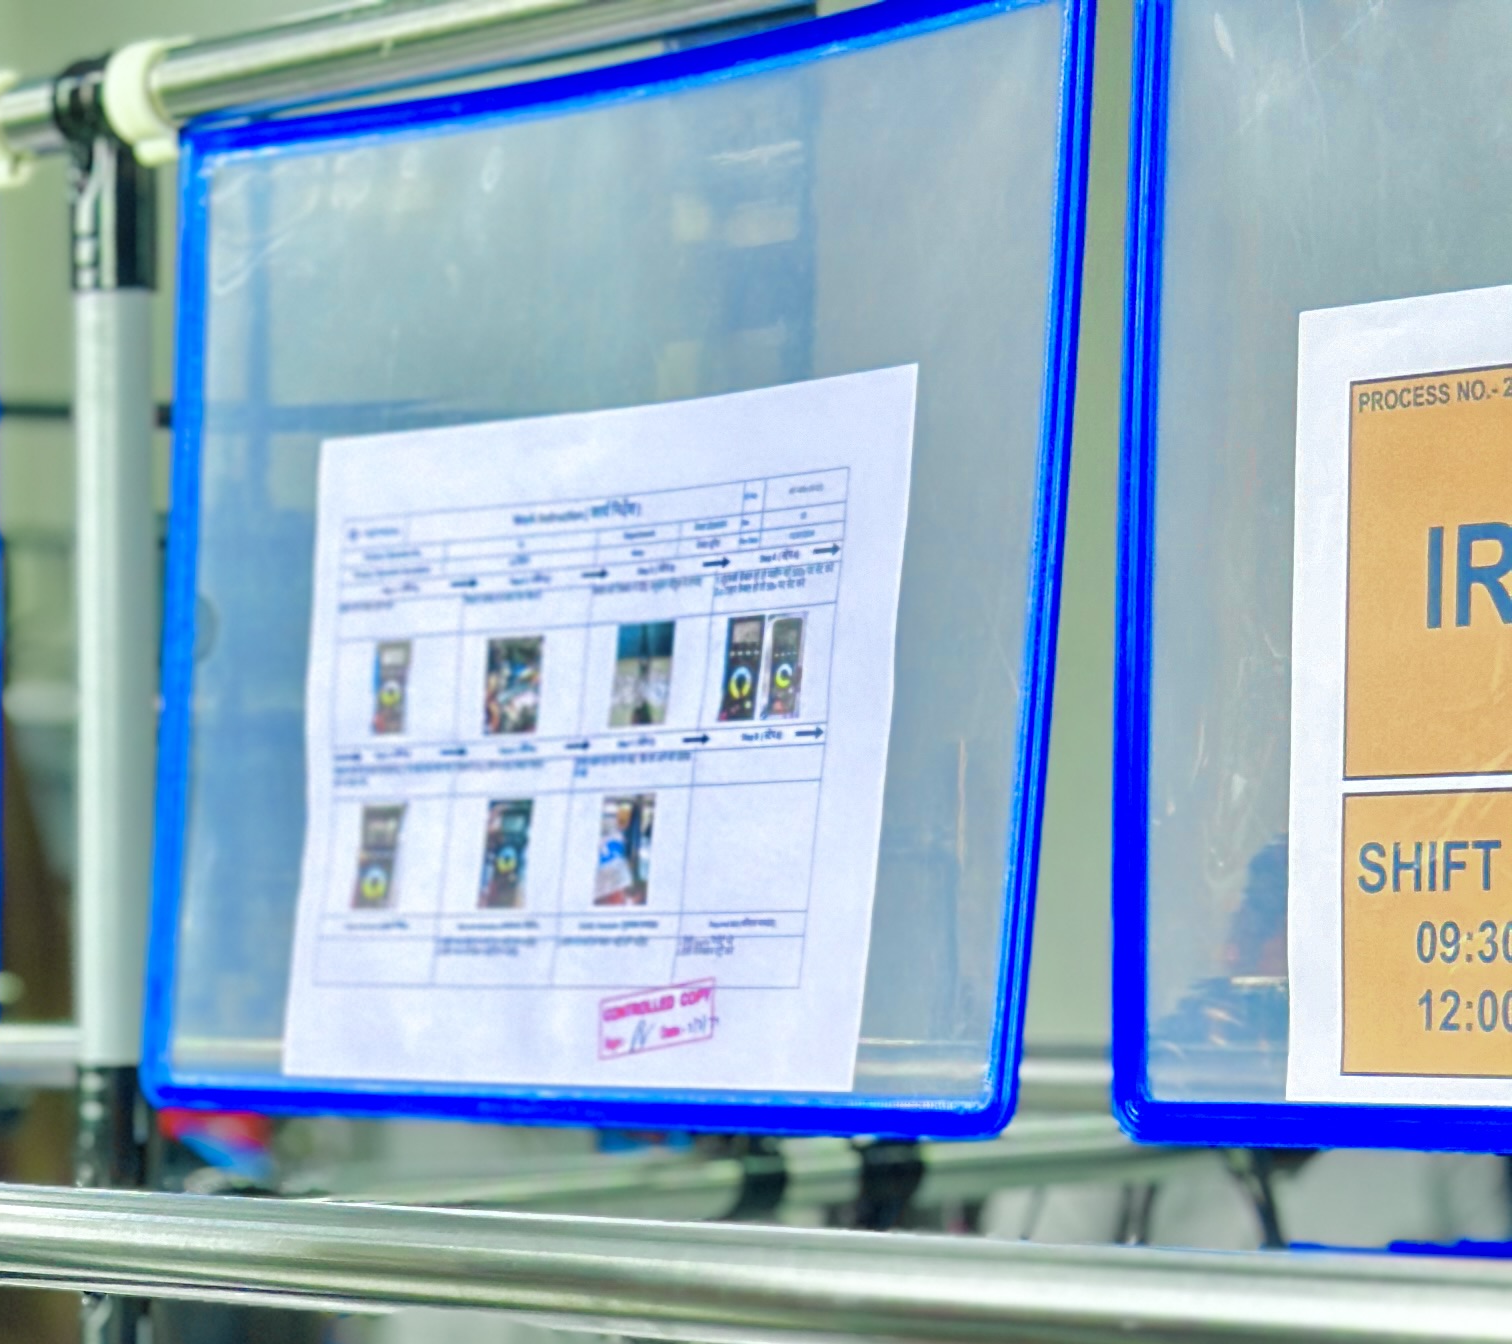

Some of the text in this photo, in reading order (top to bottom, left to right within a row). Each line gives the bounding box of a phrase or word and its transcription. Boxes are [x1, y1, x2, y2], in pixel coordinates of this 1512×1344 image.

[1358, 383, 1451, 413] PROCESS
[1427, 522, 1512, 629] IR
[1358, 840, 1502, 893] SHIFT
